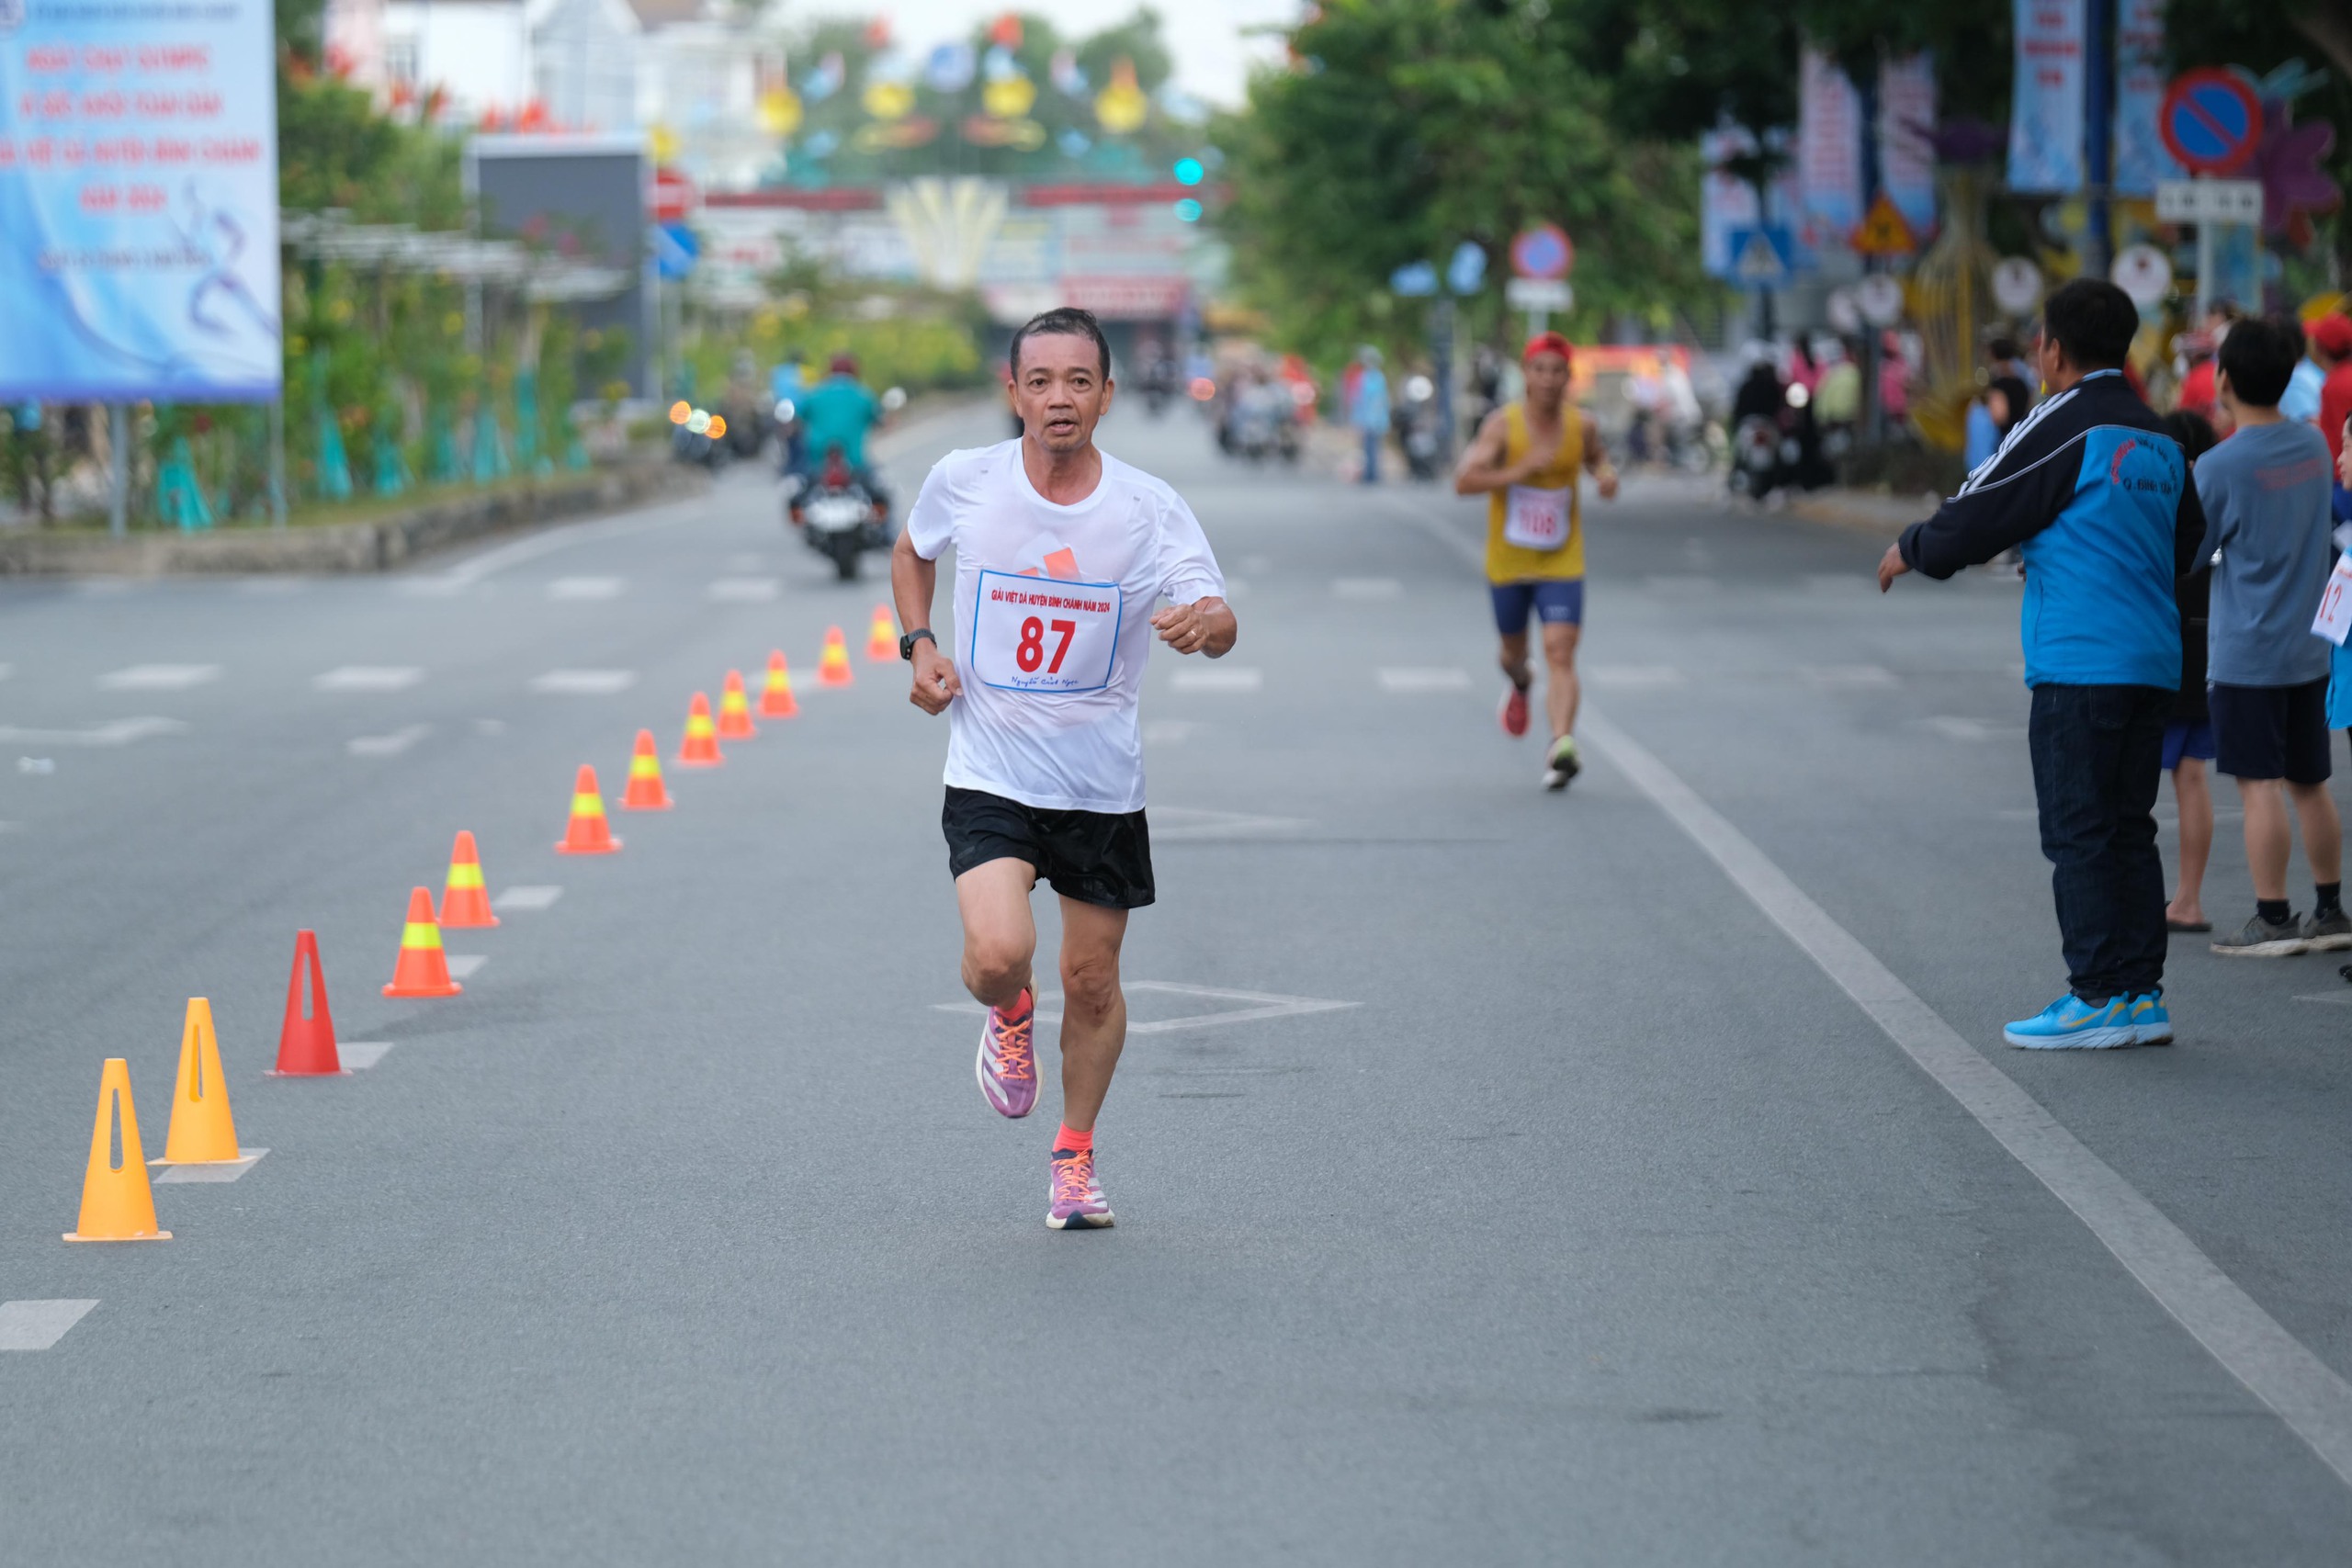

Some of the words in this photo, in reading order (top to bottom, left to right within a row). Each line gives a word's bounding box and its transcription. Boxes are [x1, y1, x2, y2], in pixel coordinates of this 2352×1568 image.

[991, 587, 1003, 602] GIẢI
[1005, 590, 1018, 604] VIỆT
[1029, 592, 1047, 608] HUYỆN
[1048, 594, 1061, 608] BÌNH
[1063, 596, 1082, 610] CHÁNH
[1083, 599, 1096, 612] NĂM
[1098, 602, 1110, 613] 2024
[1016, 616, 1076, 674] 87
